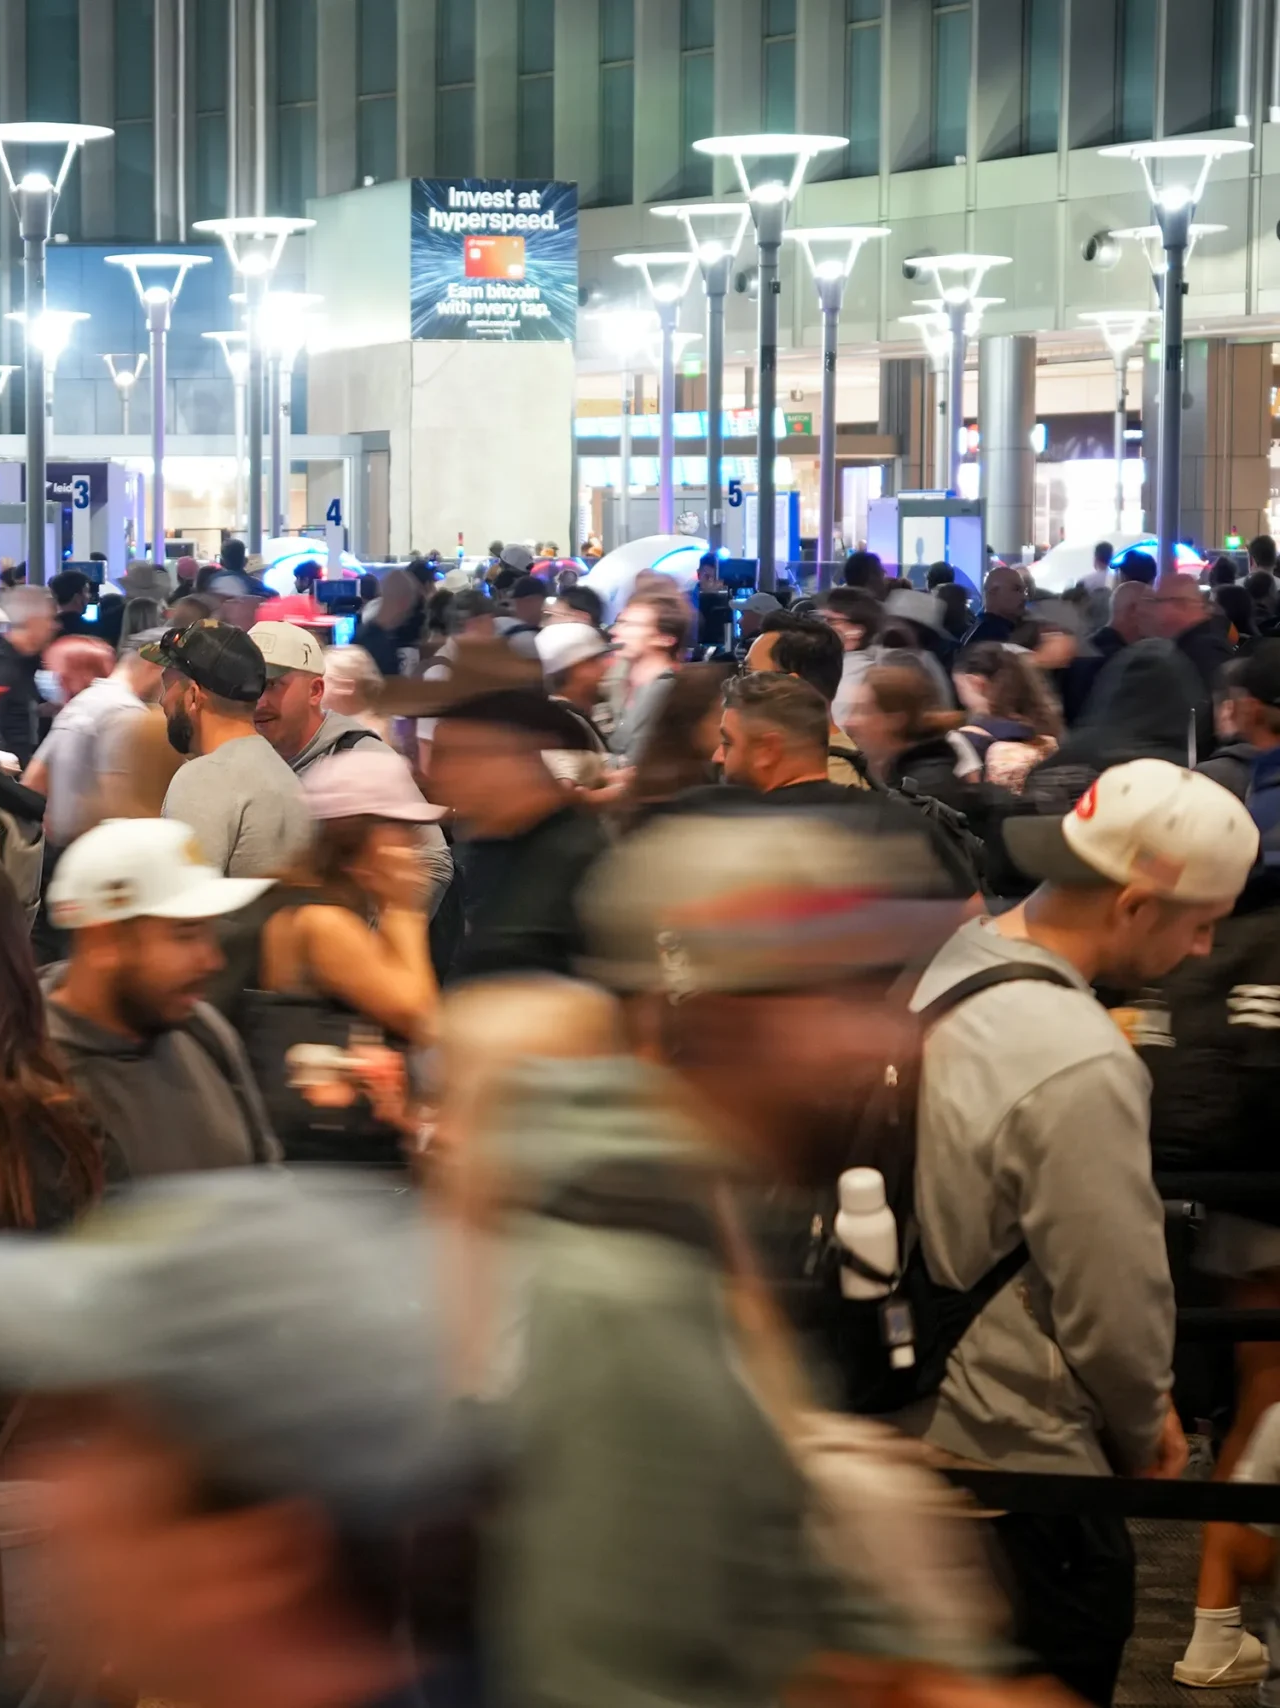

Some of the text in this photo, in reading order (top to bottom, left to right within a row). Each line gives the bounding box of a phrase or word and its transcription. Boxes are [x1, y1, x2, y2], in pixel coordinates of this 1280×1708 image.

[448, 186, 540, 208] Invest at
[429, 207, 559, 232] hyperspeed.
[448, 283, 540, 299] Earn bitcoin
[437, 299, 551, 319] with every tap.
[73, 479, 89, 509] 3
[728, 480, 743, 507] 5
[326, 498, 342, 526] 4
